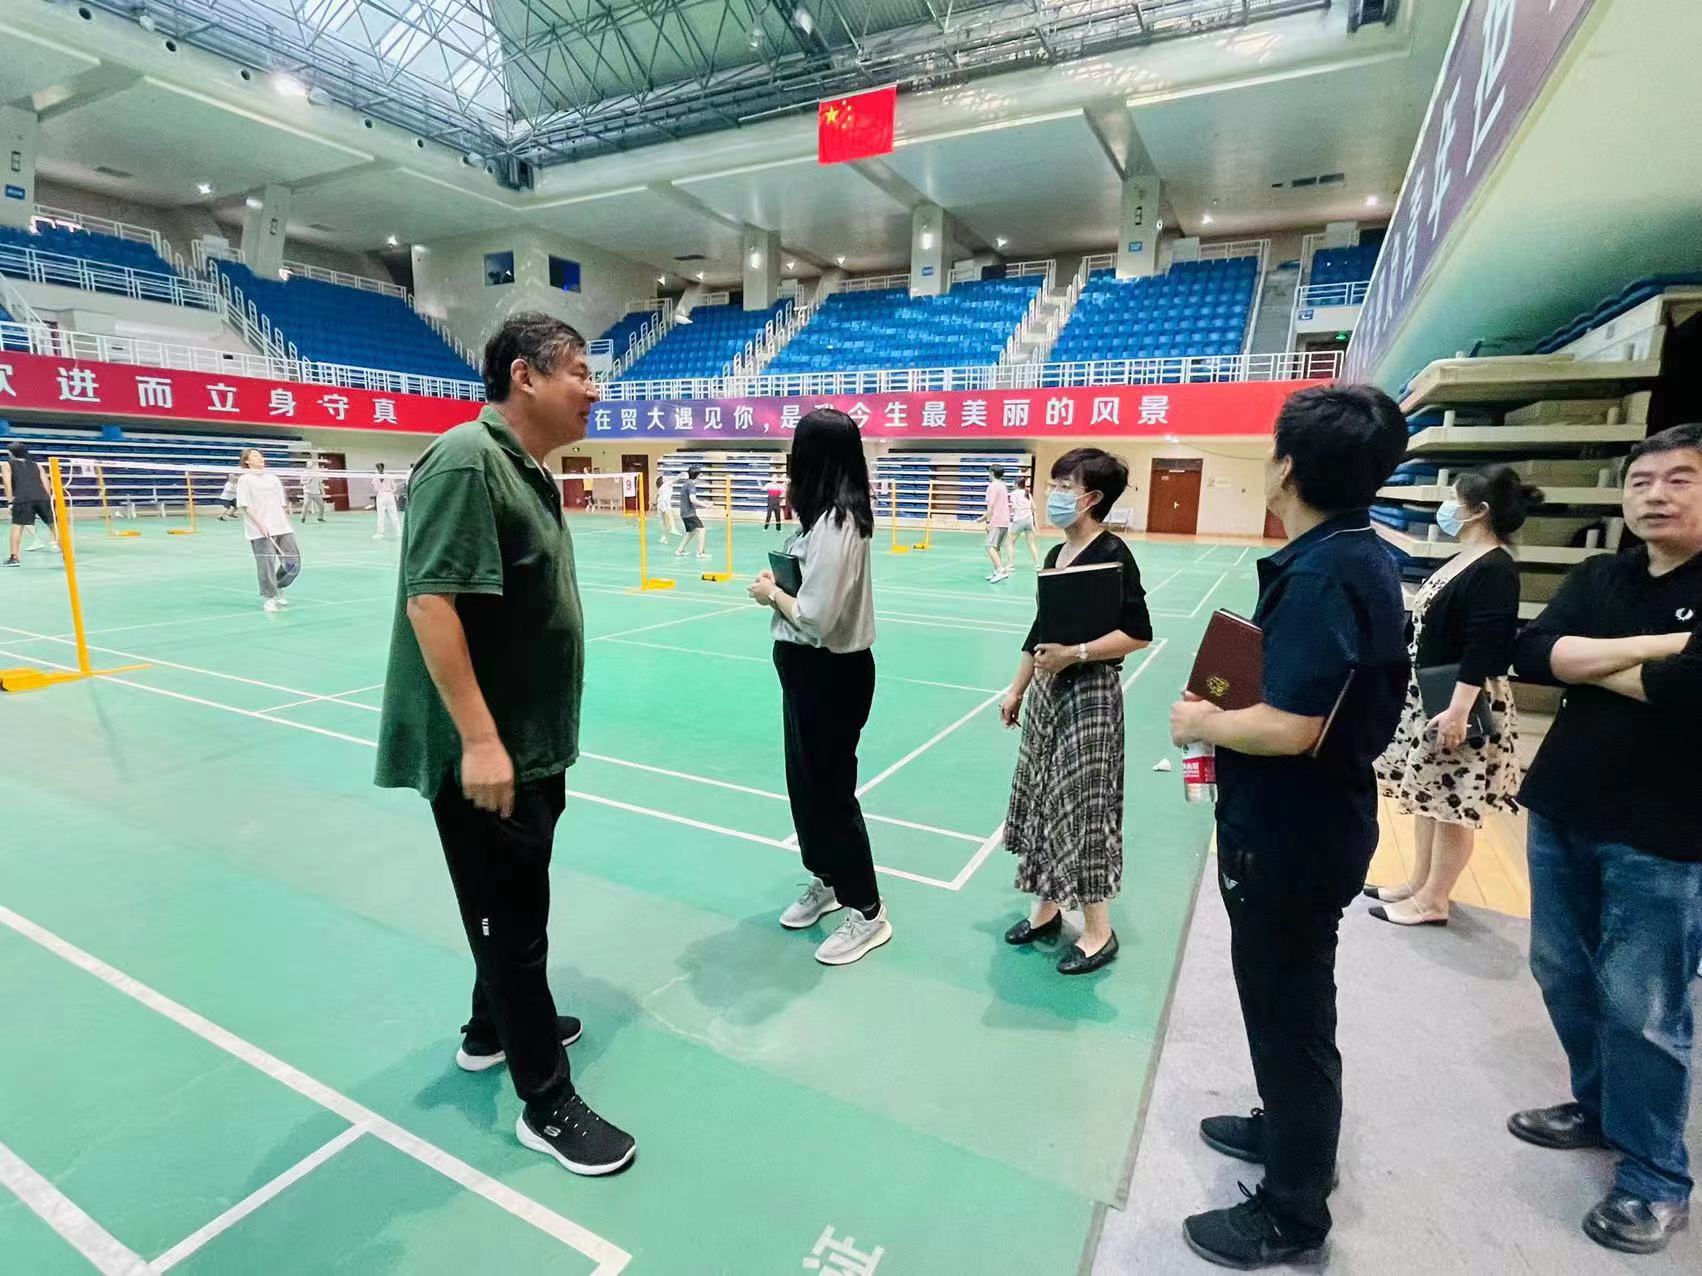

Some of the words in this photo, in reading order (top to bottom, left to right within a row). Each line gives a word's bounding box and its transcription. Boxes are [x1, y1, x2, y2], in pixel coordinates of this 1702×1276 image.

[594, 395, 1170, 432] 在贸大遇见你，是今生最美丽的风景
